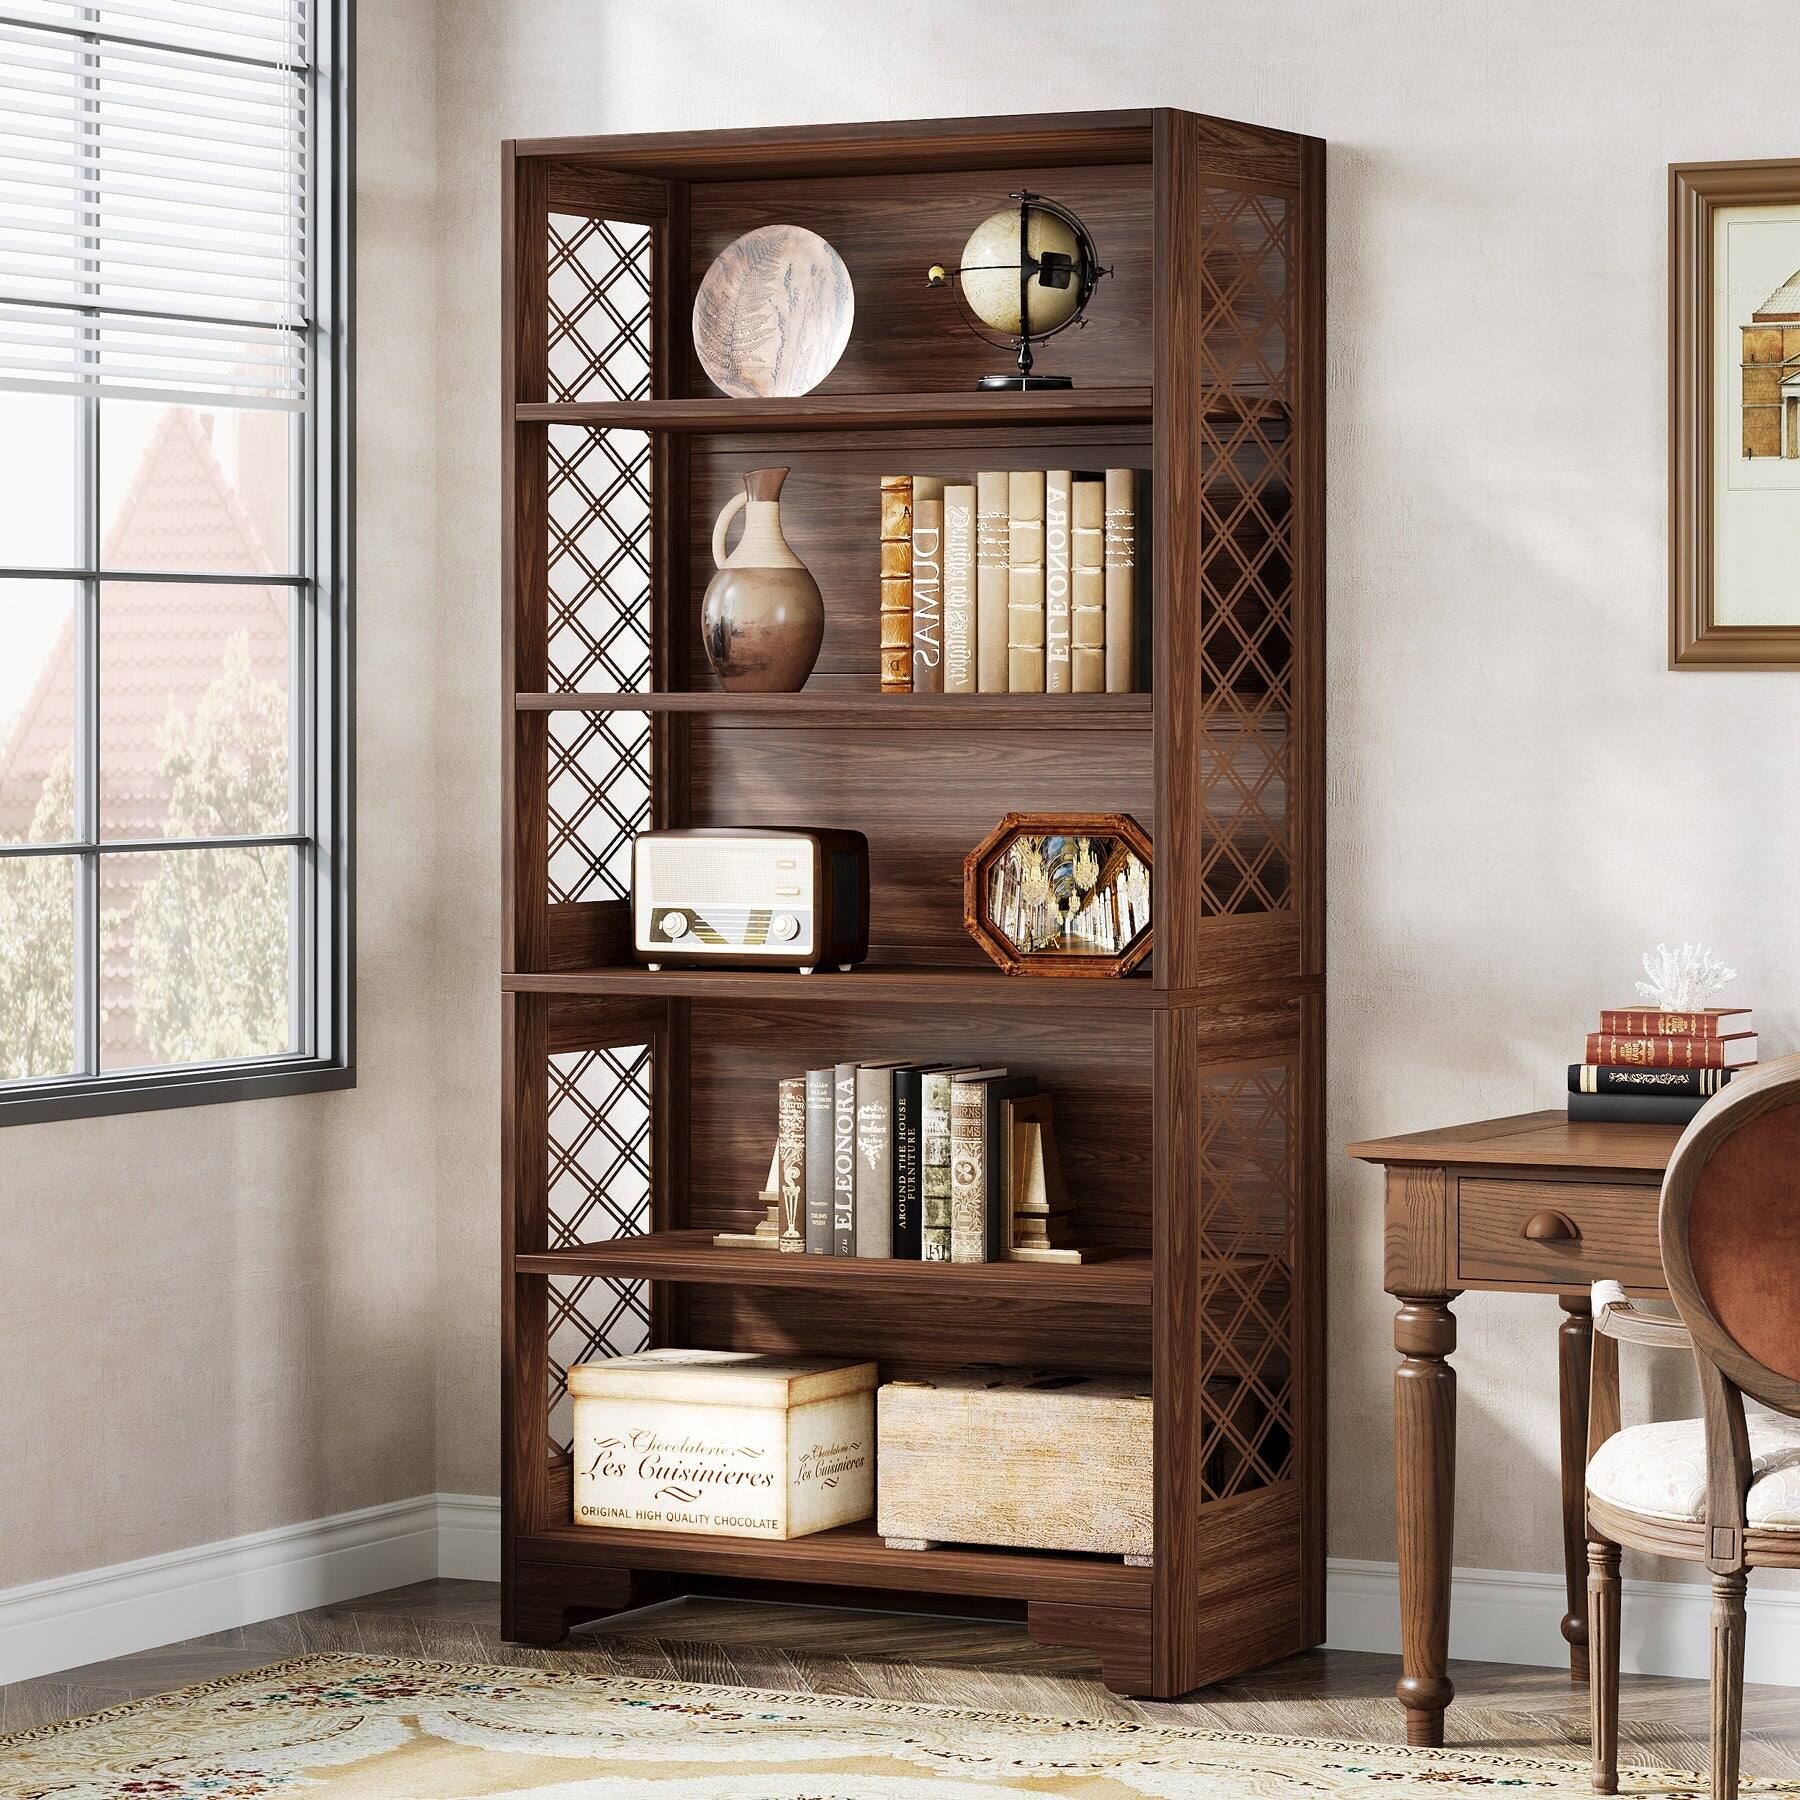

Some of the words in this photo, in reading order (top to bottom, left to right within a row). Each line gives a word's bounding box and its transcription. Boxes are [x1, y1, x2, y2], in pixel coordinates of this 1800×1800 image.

[898, 1098, 907, 1141] HOUSE
[953, 1125, 981, 1137] EMS
[834, 1077, 854, 1232] ELEONORA
[898, 1145, 907, 1171] THE
[907, 1128, 916, 1201] FURNITURE
[898, 1174, 907, 1230] AROUND
[580, 1450, 626, 1482] Les
[638, 1453, 774, 1488] Cuisinieres
[581, 1505, 631, 1519] ORIGINAL
[635, 1509, 662, 1521] HIGH
[666, 1511, 709, 1524] QUALITY
[714, 1515, 779, 1529] CHOCOLATE
